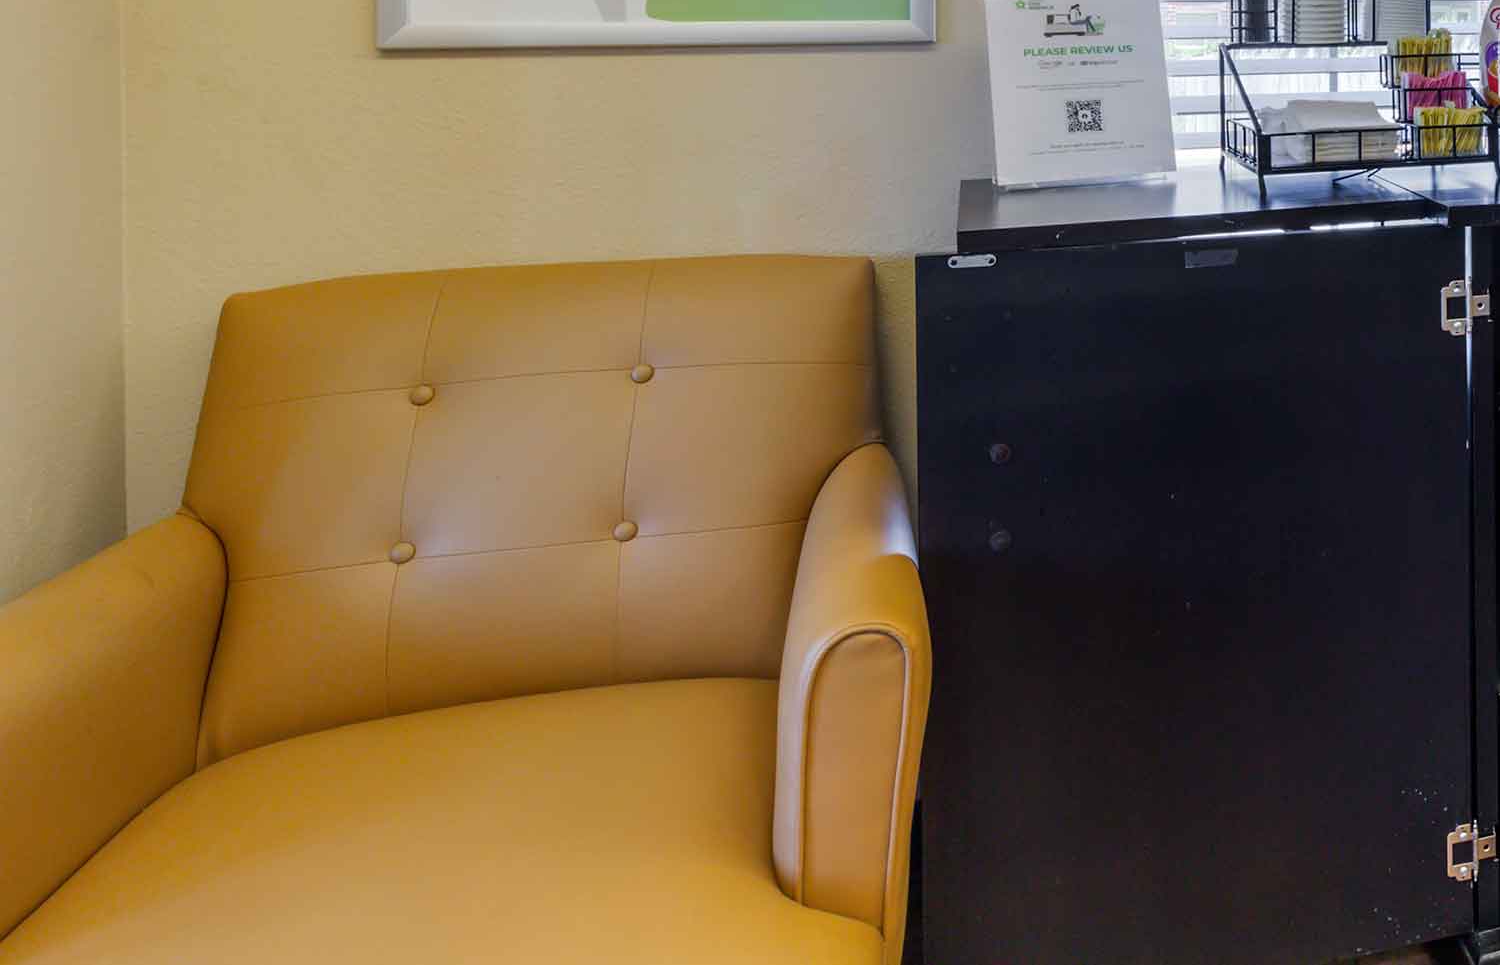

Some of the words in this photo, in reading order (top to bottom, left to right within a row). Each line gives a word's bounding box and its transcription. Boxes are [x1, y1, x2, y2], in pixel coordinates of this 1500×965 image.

[1023, 46, 1067, 57] PLEASE
[1069, 45, 1114, 55] REVIEW
[1118, 44, 1134, 53] US
